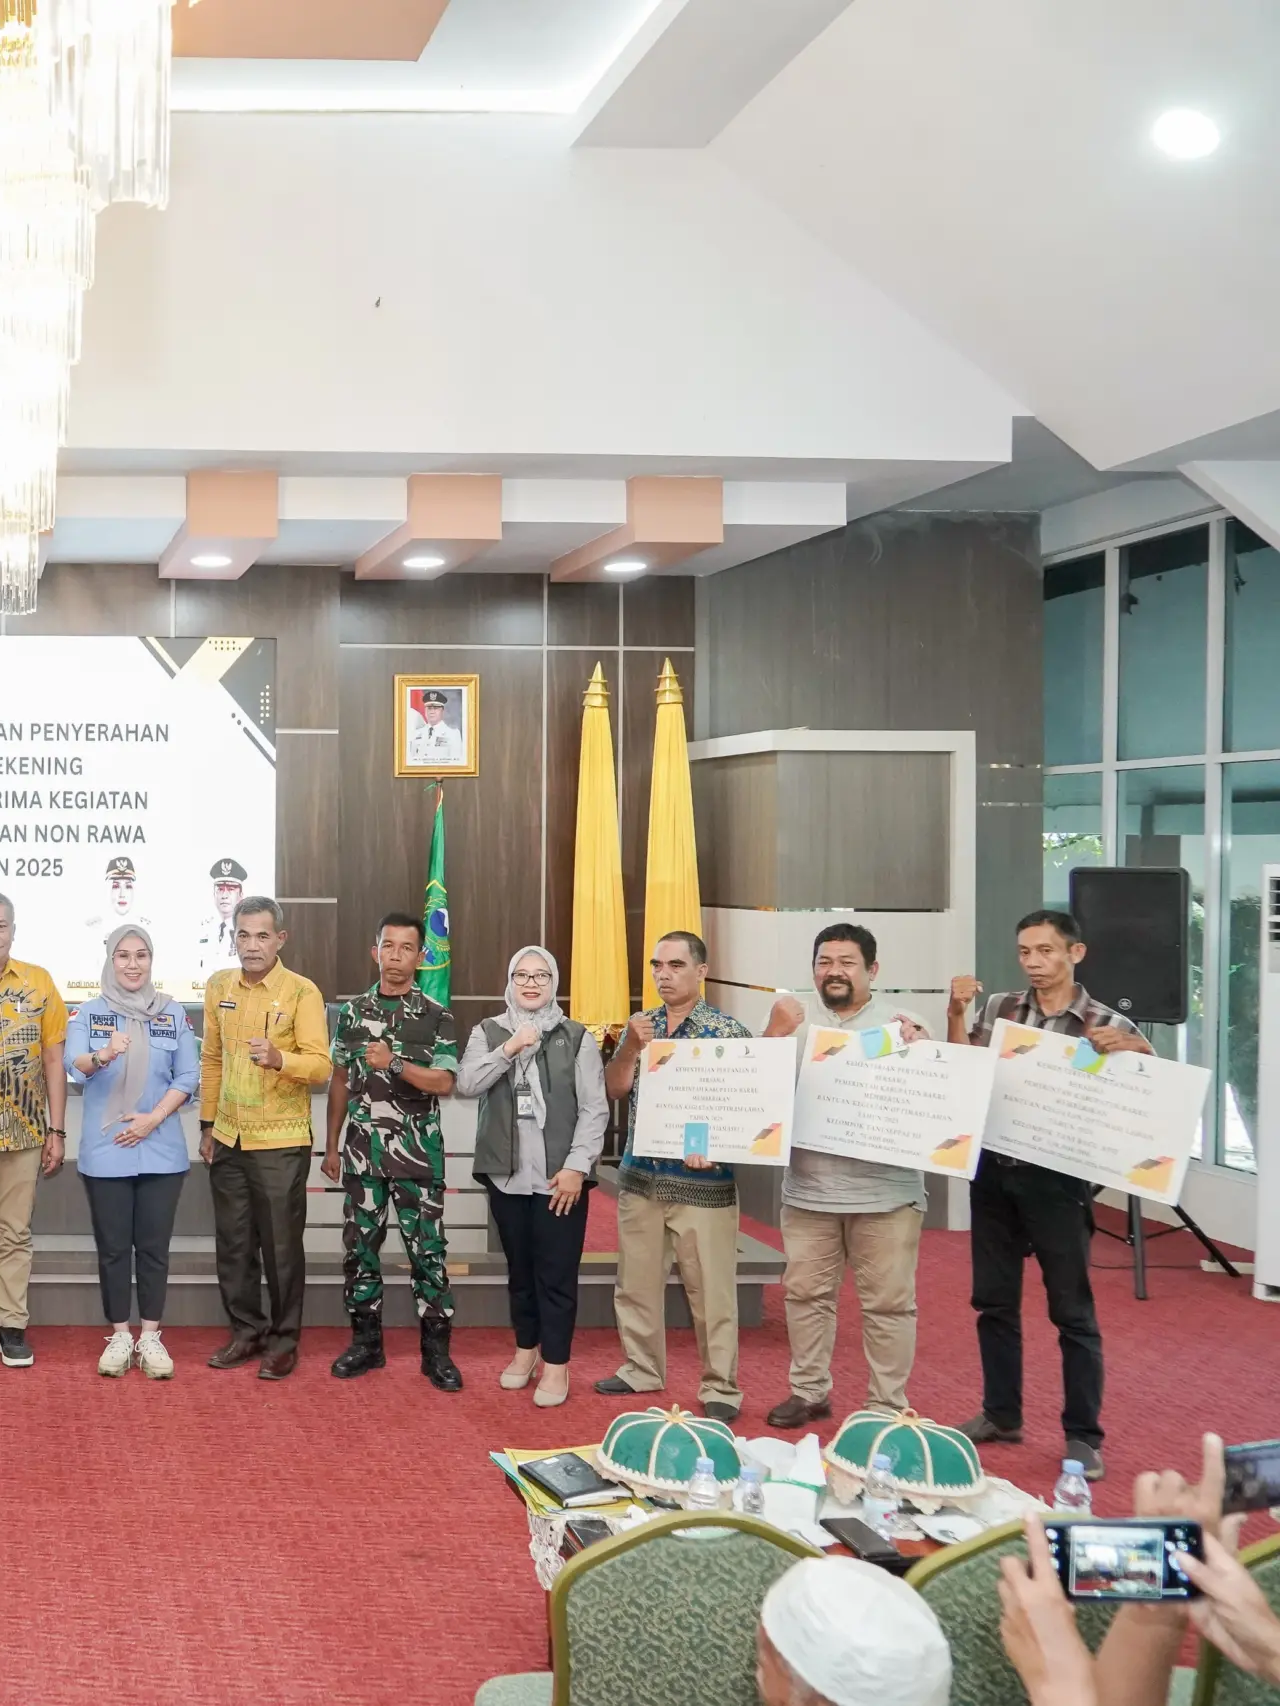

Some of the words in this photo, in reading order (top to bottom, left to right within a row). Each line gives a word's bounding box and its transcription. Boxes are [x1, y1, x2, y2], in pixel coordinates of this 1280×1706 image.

[30, 723, 169, 742] PENYERAHAN
[49, 790, 148, 810] KEGIATAN
[34, 824, 80, 843] NON
[87, 824, 146, 844] RAWA
[15, 858, 63, 877] 2025
[152, 1029, 175, 1037] BUPATI
[845, 1059, 895, 1072] KEMENTERIAN
[897, 1066, 941, 1079] PERTANIAN
[826, 1116, 864, 1129] KELOMPOK
